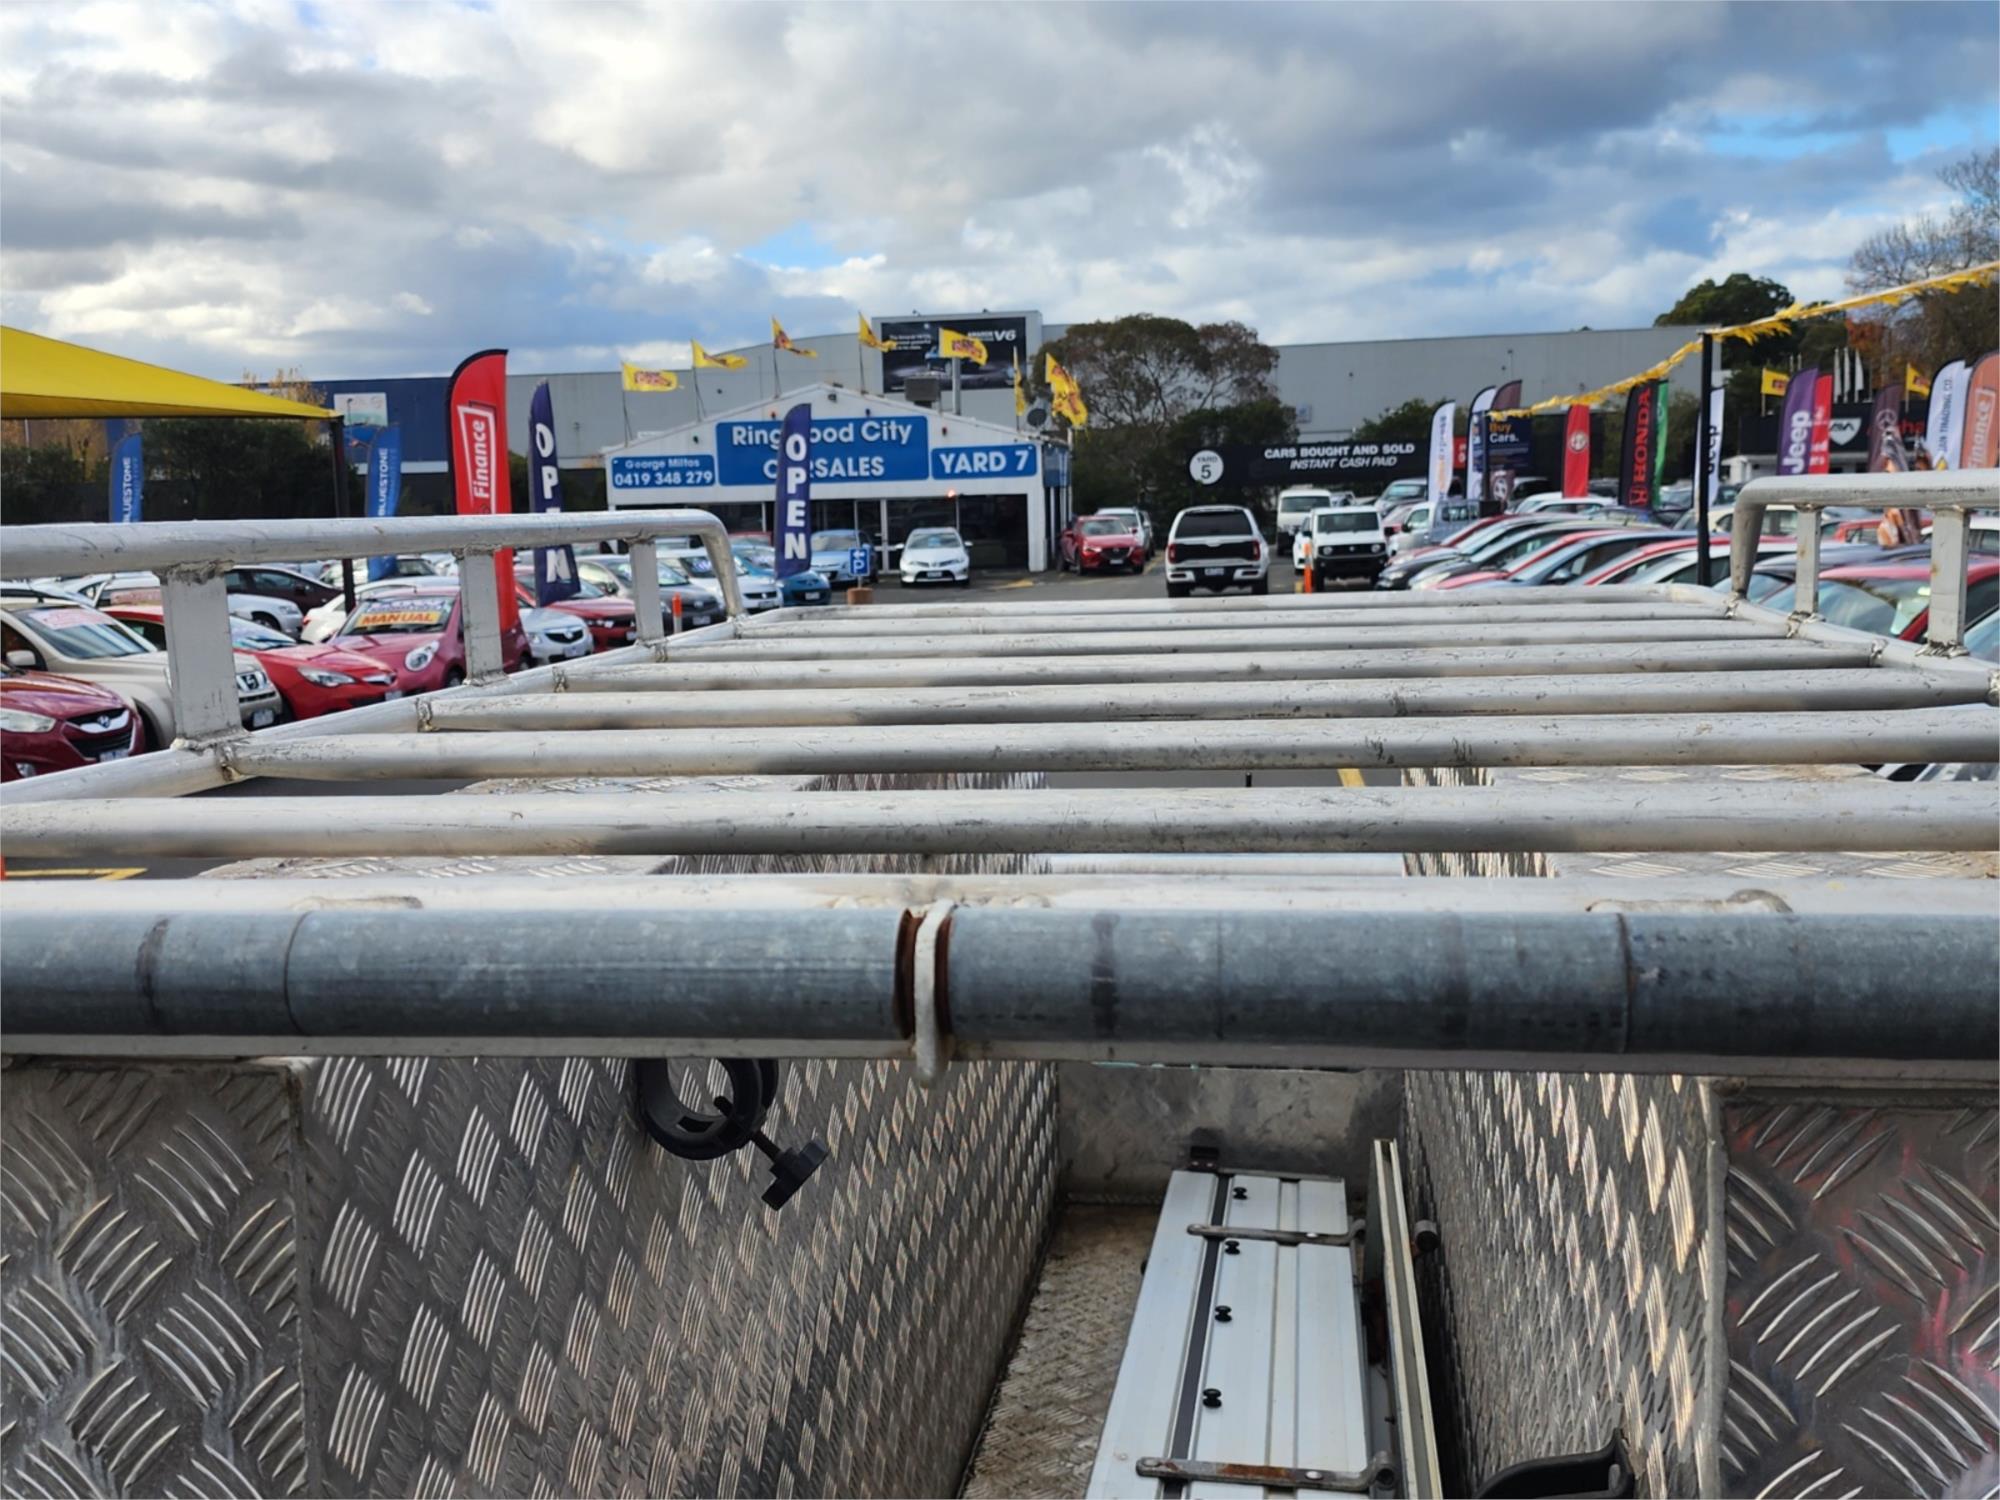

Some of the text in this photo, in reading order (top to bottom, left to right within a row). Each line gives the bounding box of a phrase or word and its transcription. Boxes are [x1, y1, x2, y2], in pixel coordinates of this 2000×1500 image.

[993, 329, 1017, 342] V6
[731, 419, 912, 450] Ringood City
[1633, 387, 1651, 481] HONDA
[1782, 410, 1812, 474] Jeep
[473, 419, 489, 499] Finance
[1264, 443, 1415, 459] CARS BOUGHT AND SOLD
[624, 459, 666, 471] George
[939, 450, 1030, 474] YARD 7
[1201, 464, 1212, 480] 5
[1290, 456, 1397, 470] INSTANT CASH PAID
[378, 447, 388, 517] BLUESTONE
[614, 470, 713, 486] 0419 348 279
[535, 423, 572, 582] OPN
[785, 433, 807, 559] OPEN
[853, 559, 865, 574] P
[362, 612, 433, 625] MANUAL
